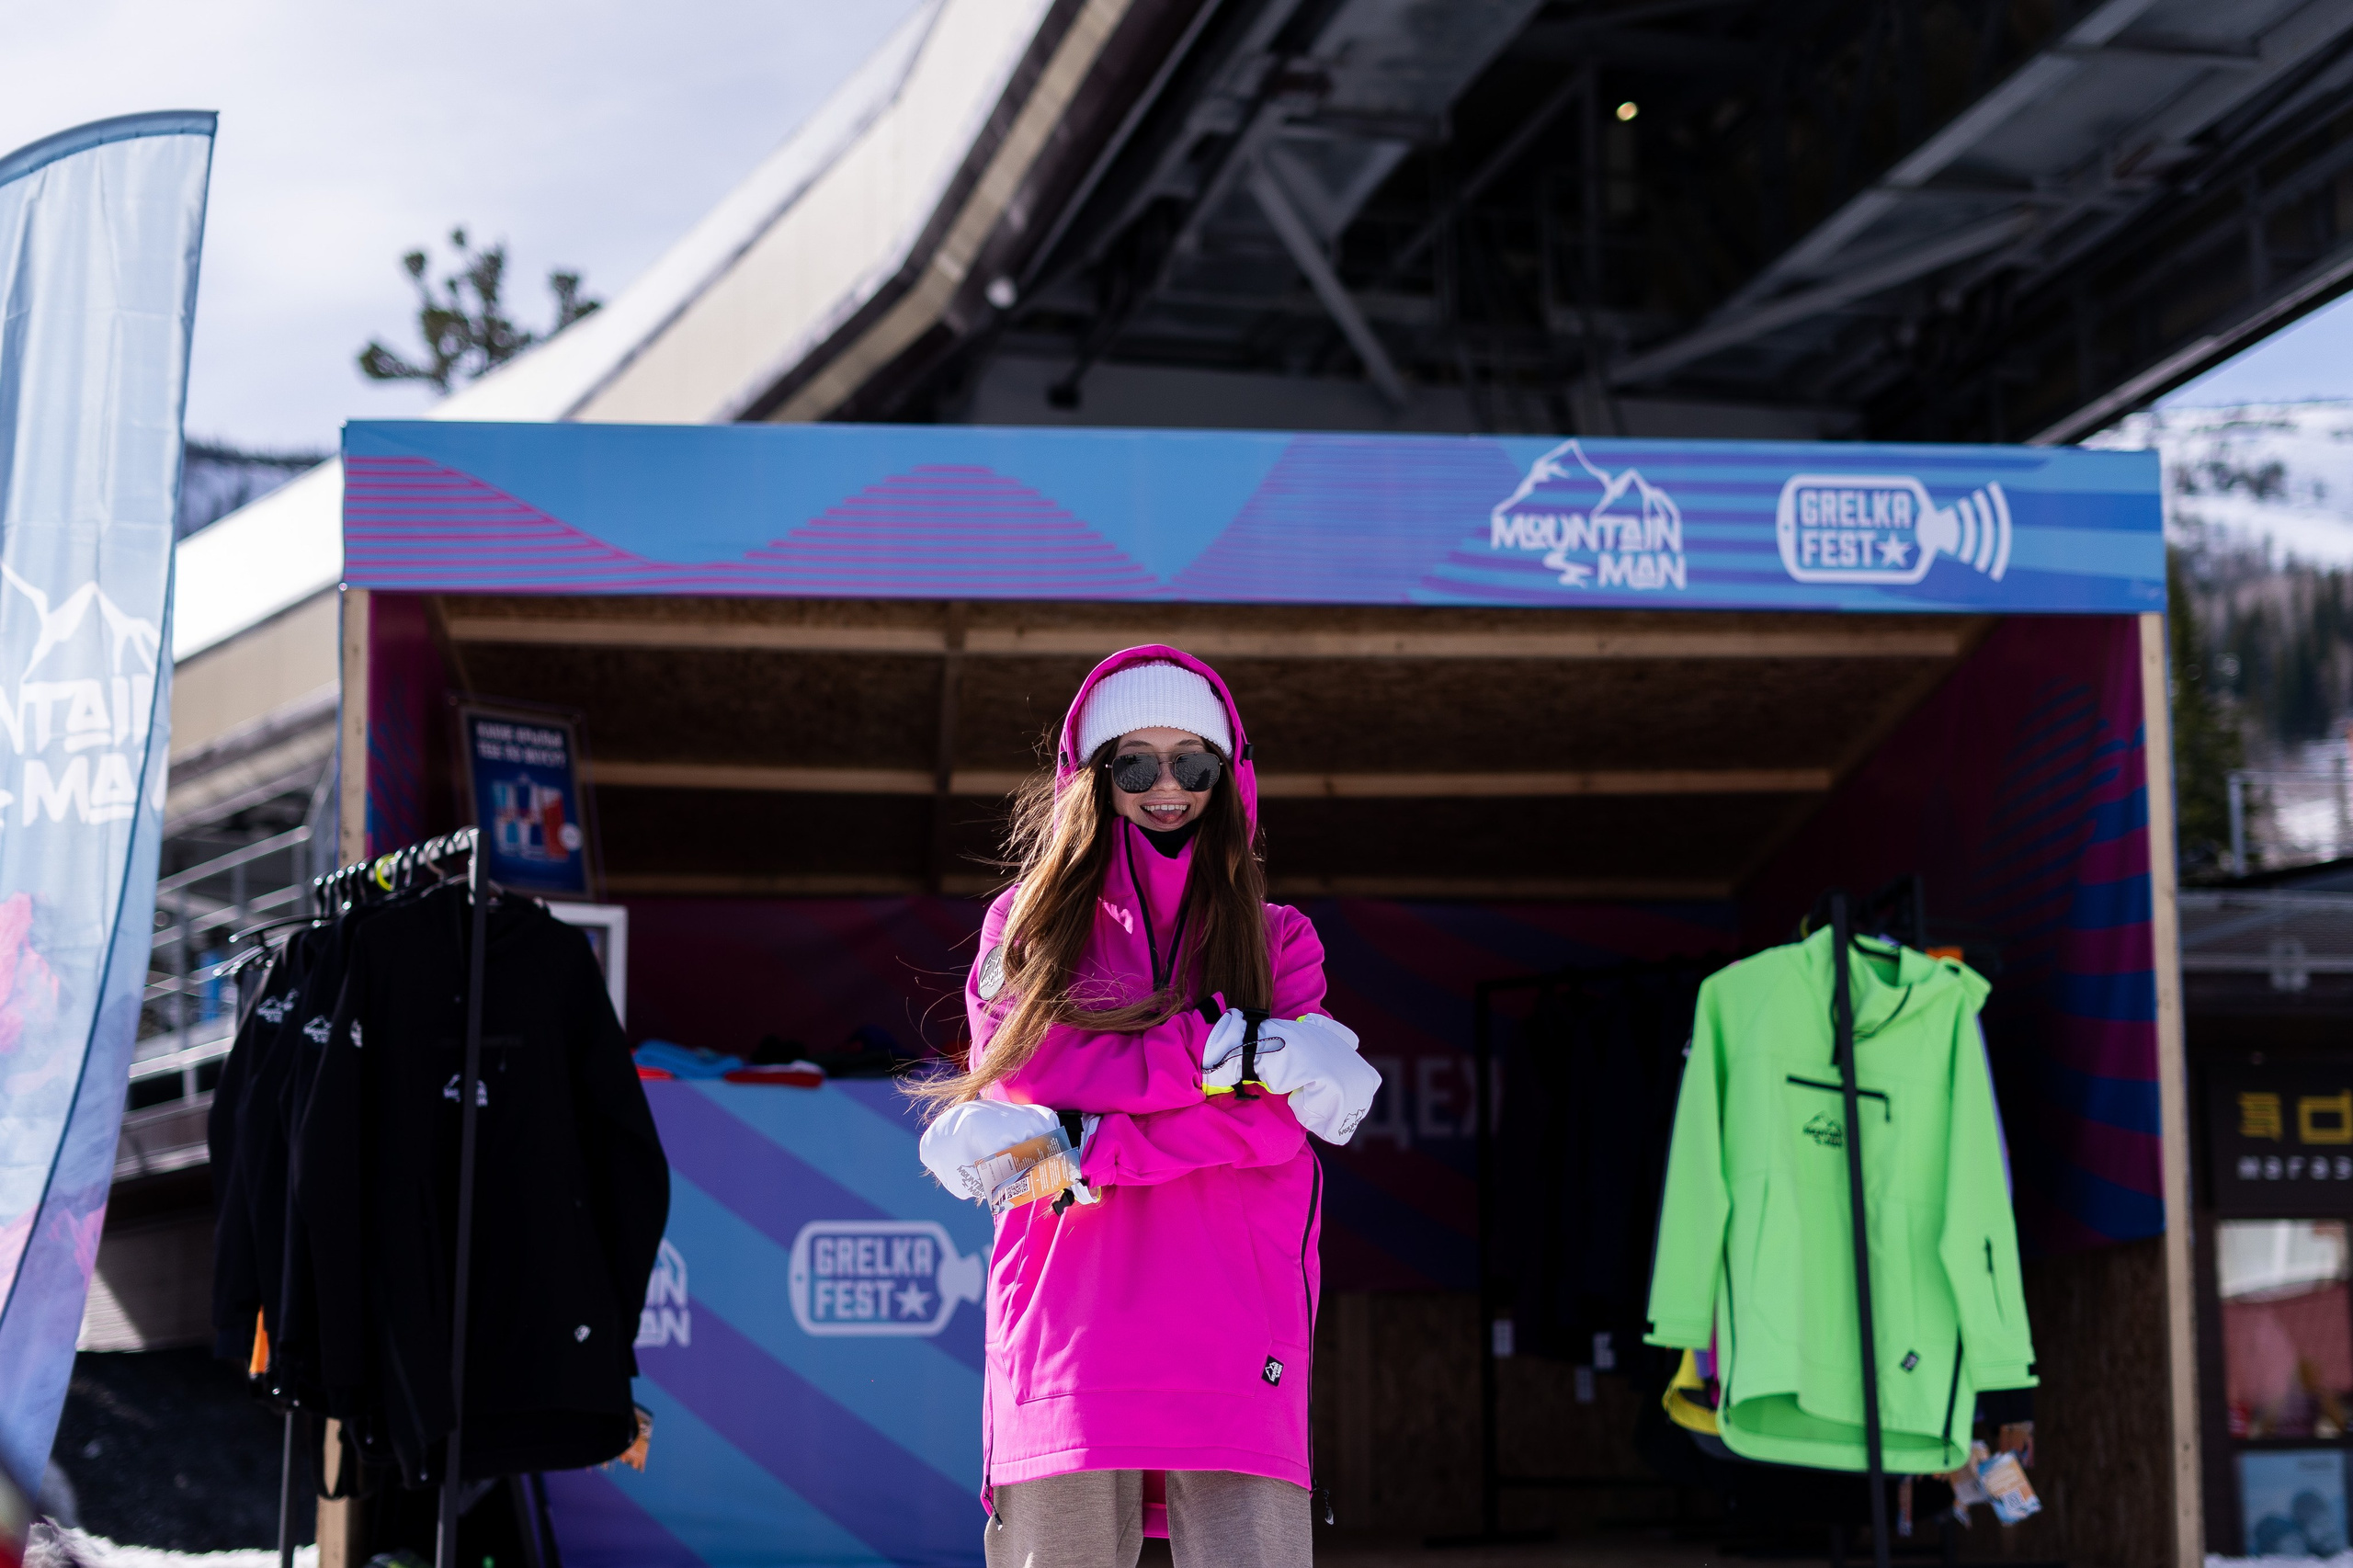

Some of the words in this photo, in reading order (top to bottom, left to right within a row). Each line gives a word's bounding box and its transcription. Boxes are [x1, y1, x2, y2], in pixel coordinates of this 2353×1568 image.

[1800, 489, 1912, 528] GRELKA
[1490, 511, 1683, 552] MOUNTAIN
[1801, 528, 1878, 568] FEST
[1597, 551, 1687, 590] MAN
[814, 1238, 934, 1277] GRELKA
[814, 1278, 897, 1319] FEST
